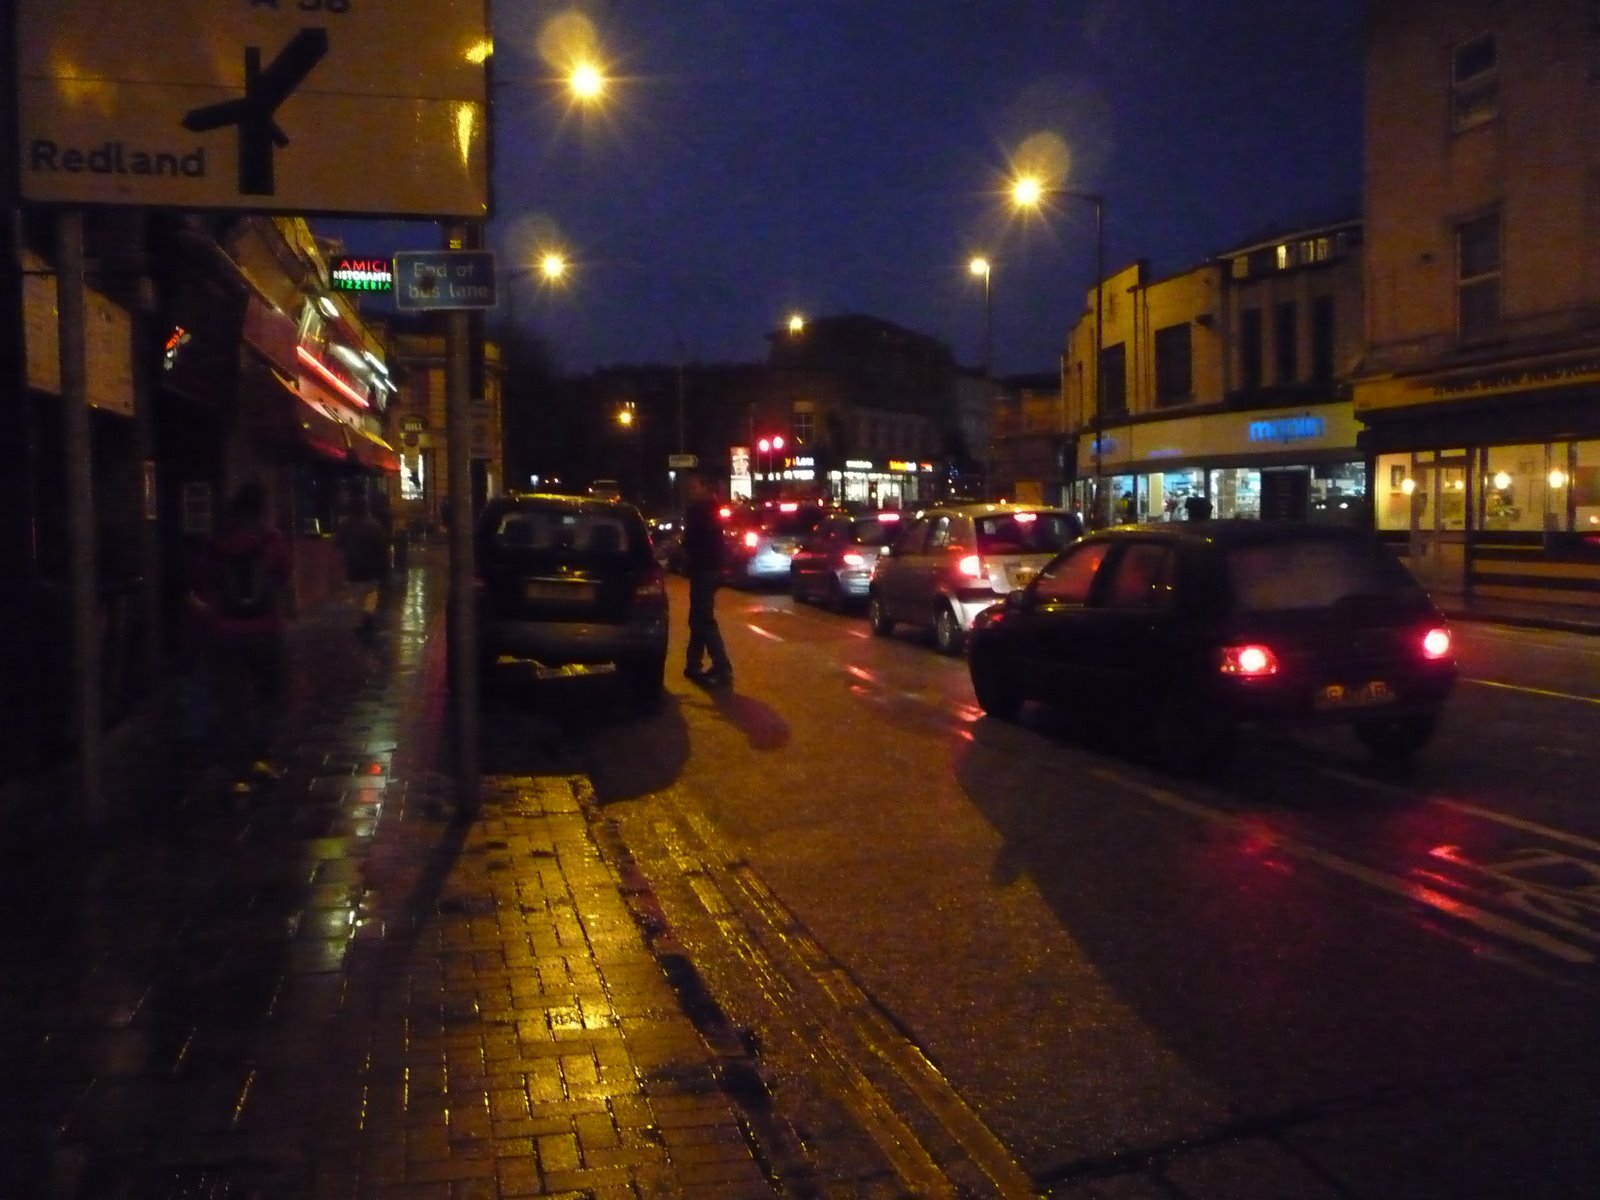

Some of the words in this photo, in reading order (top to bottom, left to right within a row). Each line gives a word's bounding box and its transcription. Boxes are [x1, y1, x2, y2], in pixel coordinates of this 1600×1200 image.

[32, 139, 204, 176] Redland
[340, 260, 387, 272] AMICI
[413, 262, 448, 278] End
[455, 263, 475, 278] of
[333, 270, 392, 282] RISTORANTE
[408, 283, 441, 298] bus
[449, 282, 488, 298] lane
